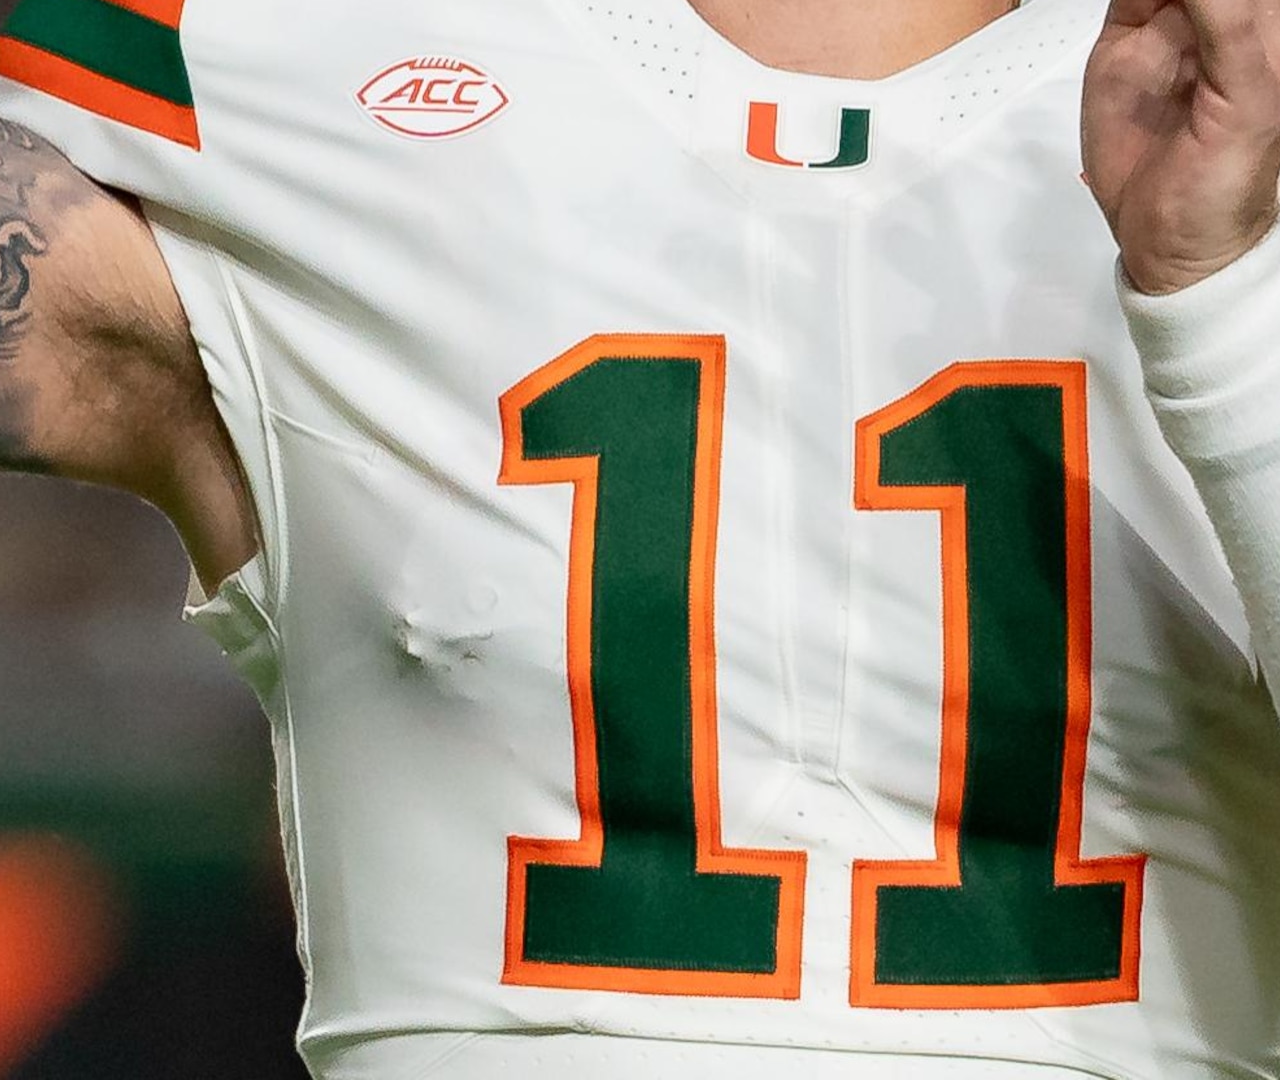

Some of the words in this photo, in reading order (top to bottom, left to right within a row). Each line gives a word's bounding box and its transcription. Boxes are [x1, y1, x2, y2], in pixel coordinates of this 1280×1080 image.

[380, 79, 487, 105] ACC
[746, 101, 871, 168] U
[497, 333, 1148, 1009] 11
